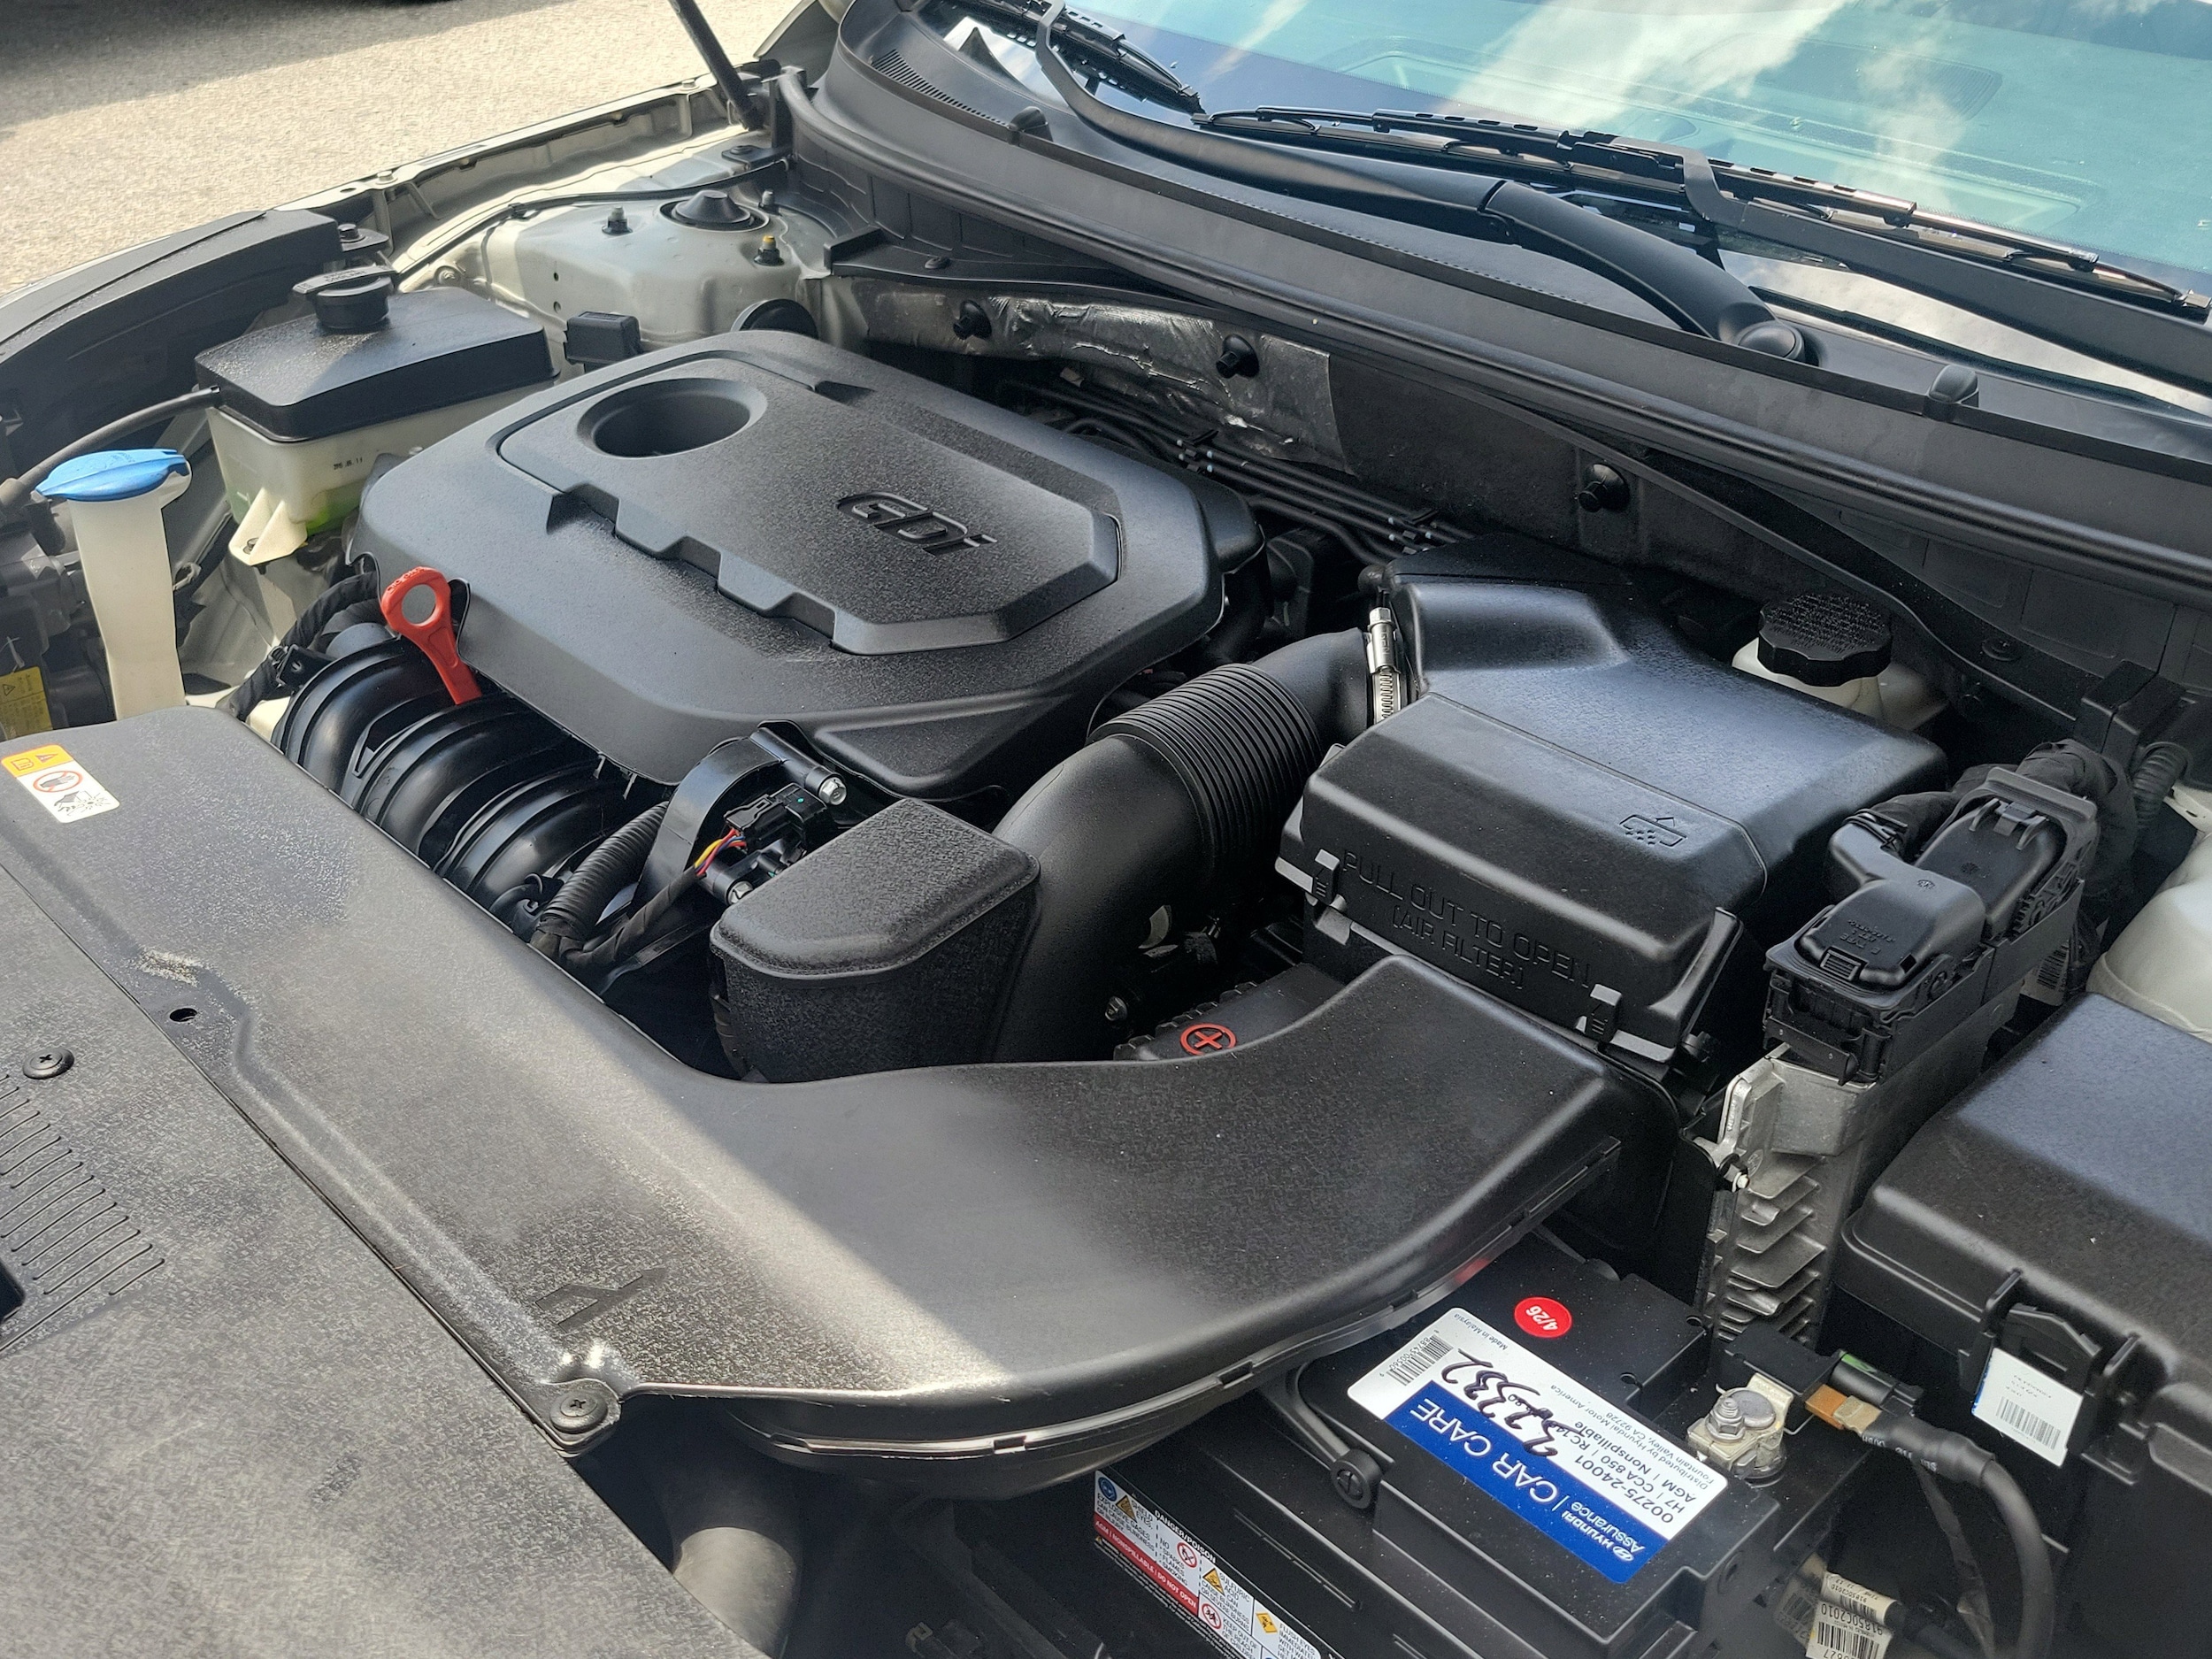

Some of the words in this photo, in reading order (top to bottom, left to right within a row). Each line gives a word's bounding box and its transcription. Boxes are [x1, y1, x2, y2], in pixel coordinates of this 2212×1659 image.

[835, 492, 997, 557] GDi
[1343, 849, 1403, 901] PULL
[1410, 885, 1463, 926] OUT
[1471, 910, 1504, 949] TO
[1513, 933, 1590, 988] OPEN
[1452, 1312, 1484, 1333] Malaysia
[1525, 1305, 1558, 1330] 4/26
[1487, 1335, 1508, 1349] Made
[1548, 1384, 1584, 1409] America
[1408, 1397, 1496, 1460] CARE
[1583, 1407, 1610, 1426] Motor
[1604, 1411, 1632, 1431] 92728
[1569, 1434, 1591, 1450] RC
[1609, 1423, 1647, 1450] Hyundai
[1631, 1428, 1647, 1440] CA
[1571, 1419, 1653, 1475] Nonspillable
[1645, 1437, 1677, 1458] Valley,
[1645, 1447, 1660, 1458] by
[1599, 1454, 1626, 1474] 850
[1657, 1455, 1709, 1490] Distributed
[1673, 1455, 1715, 1484] Fountain
[1487, 1451, 1563, 1506] CAR
[1573, 1454, 1676, 1524] 00275-24001
[1624, 1470, 1655, 1494] CCA
[1661, 1479, 1696, 1503] AGM
[1097, 1492, 1128, 1524] EXPLOSIVE
[1131, 1519, 1149, 1540] GASES
[1132, 1499, 1152, 1522] SHIELD
[1663, 1496, 1686, 1513] H7
[1097, 1500, 1107, 1512] CAN
[1108, 1509, 1125, 1527] CAUSE
[1125, 1524, 1154, 1551] BLINDNESS
[1155, 1510, 1217, 1563] DANGER/POISON
[1559, 1509, 1615, 1548] HYUNDAI
[1567, 1500, 1646, 1555] Assurance
[1160, 1537, 1169, 1550] NO
[1095, 1520, 1108, 1534] AGM
[1112, 1533, 1154, 1573] NONSPILLABLE
[1158, 1571, 1165, 1583] DO
[1166, 1578, 1179, 1594] NOT
[1179, 1590, 1195, 1609] OPEN
[1163, 1548, 1184, 1570] SPARKS
[1163, 1555, 1184, 1577] FLAMES
[1163, 1561, 1187, 1586] SMOKING
[1219, 1571, 1249, 1602] SULFURIC
[1224, 1583, 1238, 1601] ACID
[1202, 1579, 1217, 1598] CAUSE
[1220, 1595, 1249, 1624] BLINDNESS
[1210, 1593, 1229, 1615] SEVERE
[1226, 1593, 1238, 1608] CAN
[1223, 1617, 1237, 1632] KEEP
[1237, 1628, 1248, 1643] OUT
[1821, 1603, 1883, 1636] 91850C2010
[1223, 1624, 1233, 1636] THE
[1234, 1633, 1252, 1654] REACH
[1279, 1622, 1298, 1642] FLUSH
[1300, 1639, 1315, 1656] EYES
